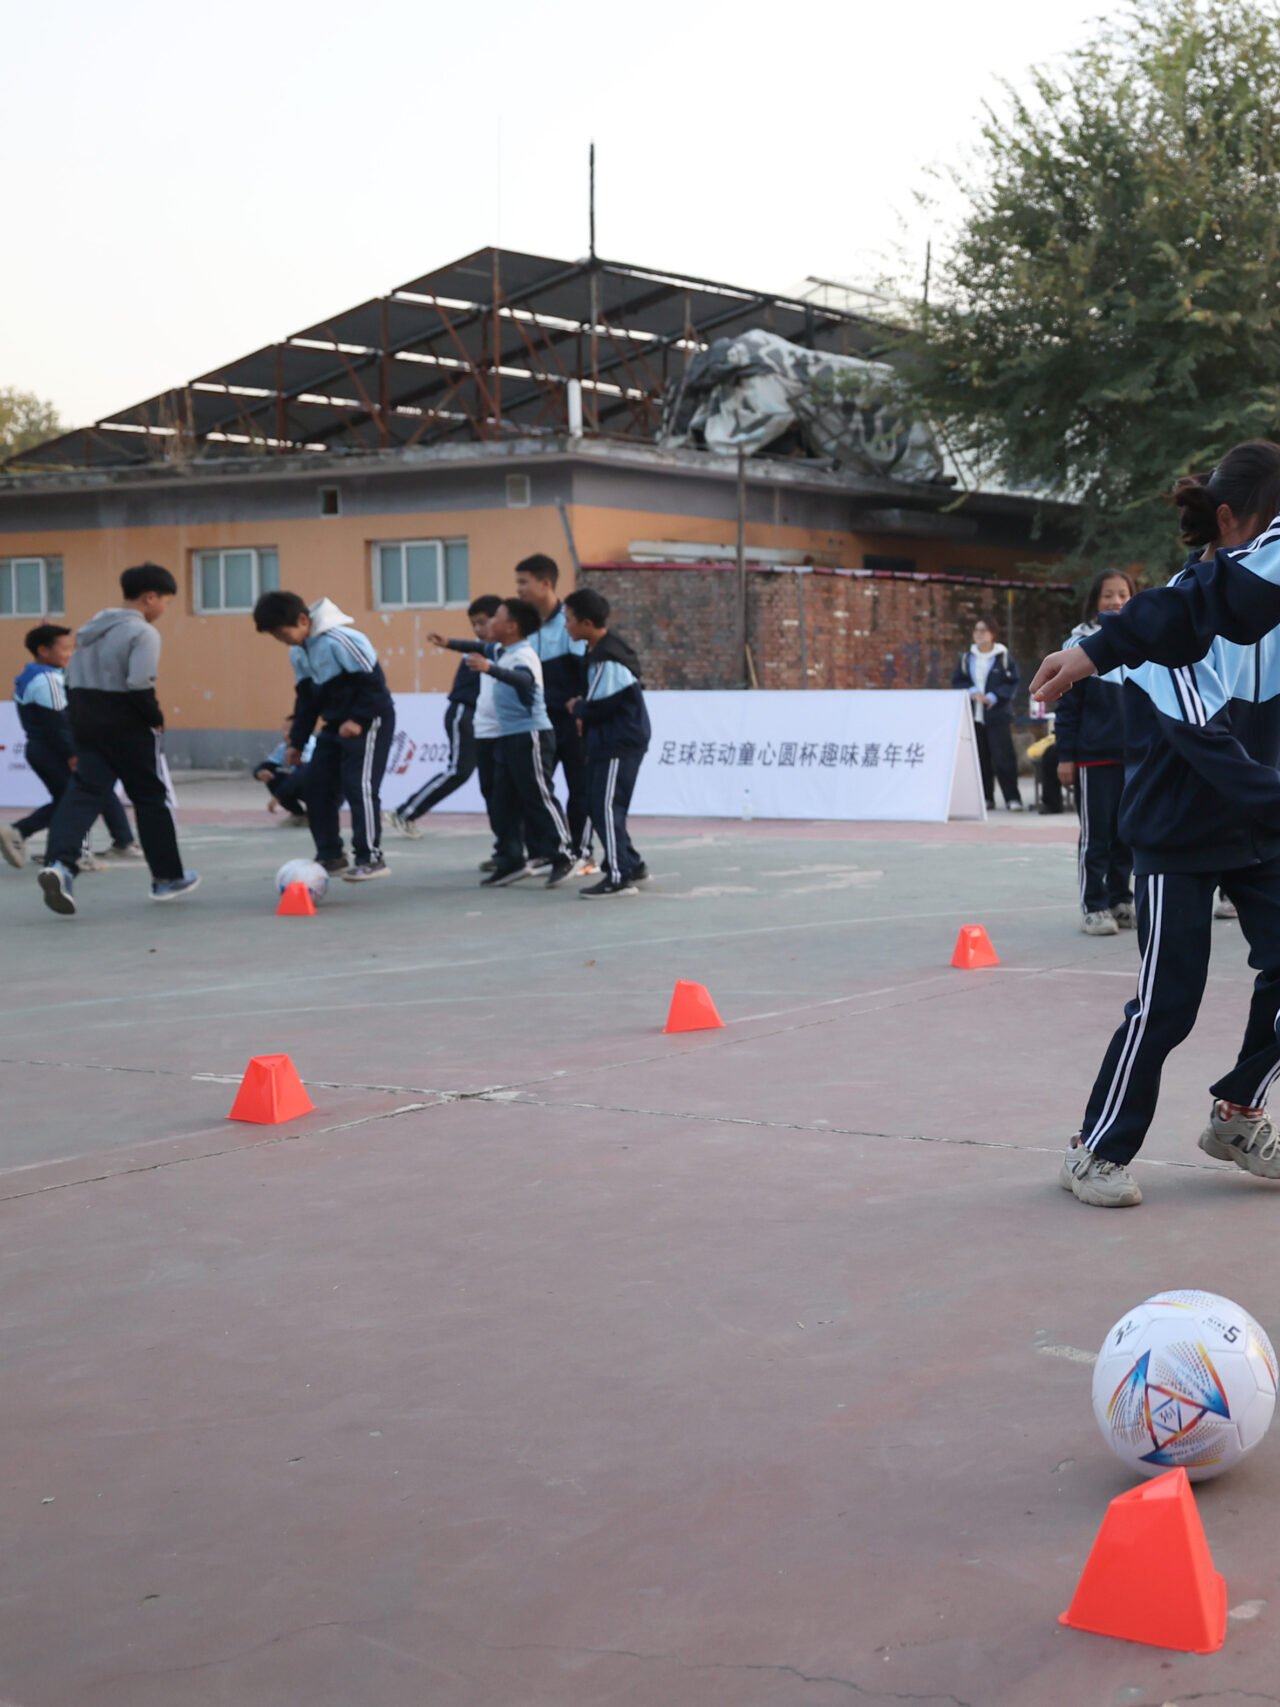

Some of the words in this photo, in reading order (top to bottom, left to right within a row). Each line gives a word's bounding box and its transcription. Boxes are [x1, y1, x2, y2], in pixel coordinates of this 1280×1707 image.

[658, 741, 925, 768] 足球活动童心圆杯趣味嘉年华
[1223, 1326, 1241, 1343] 5
